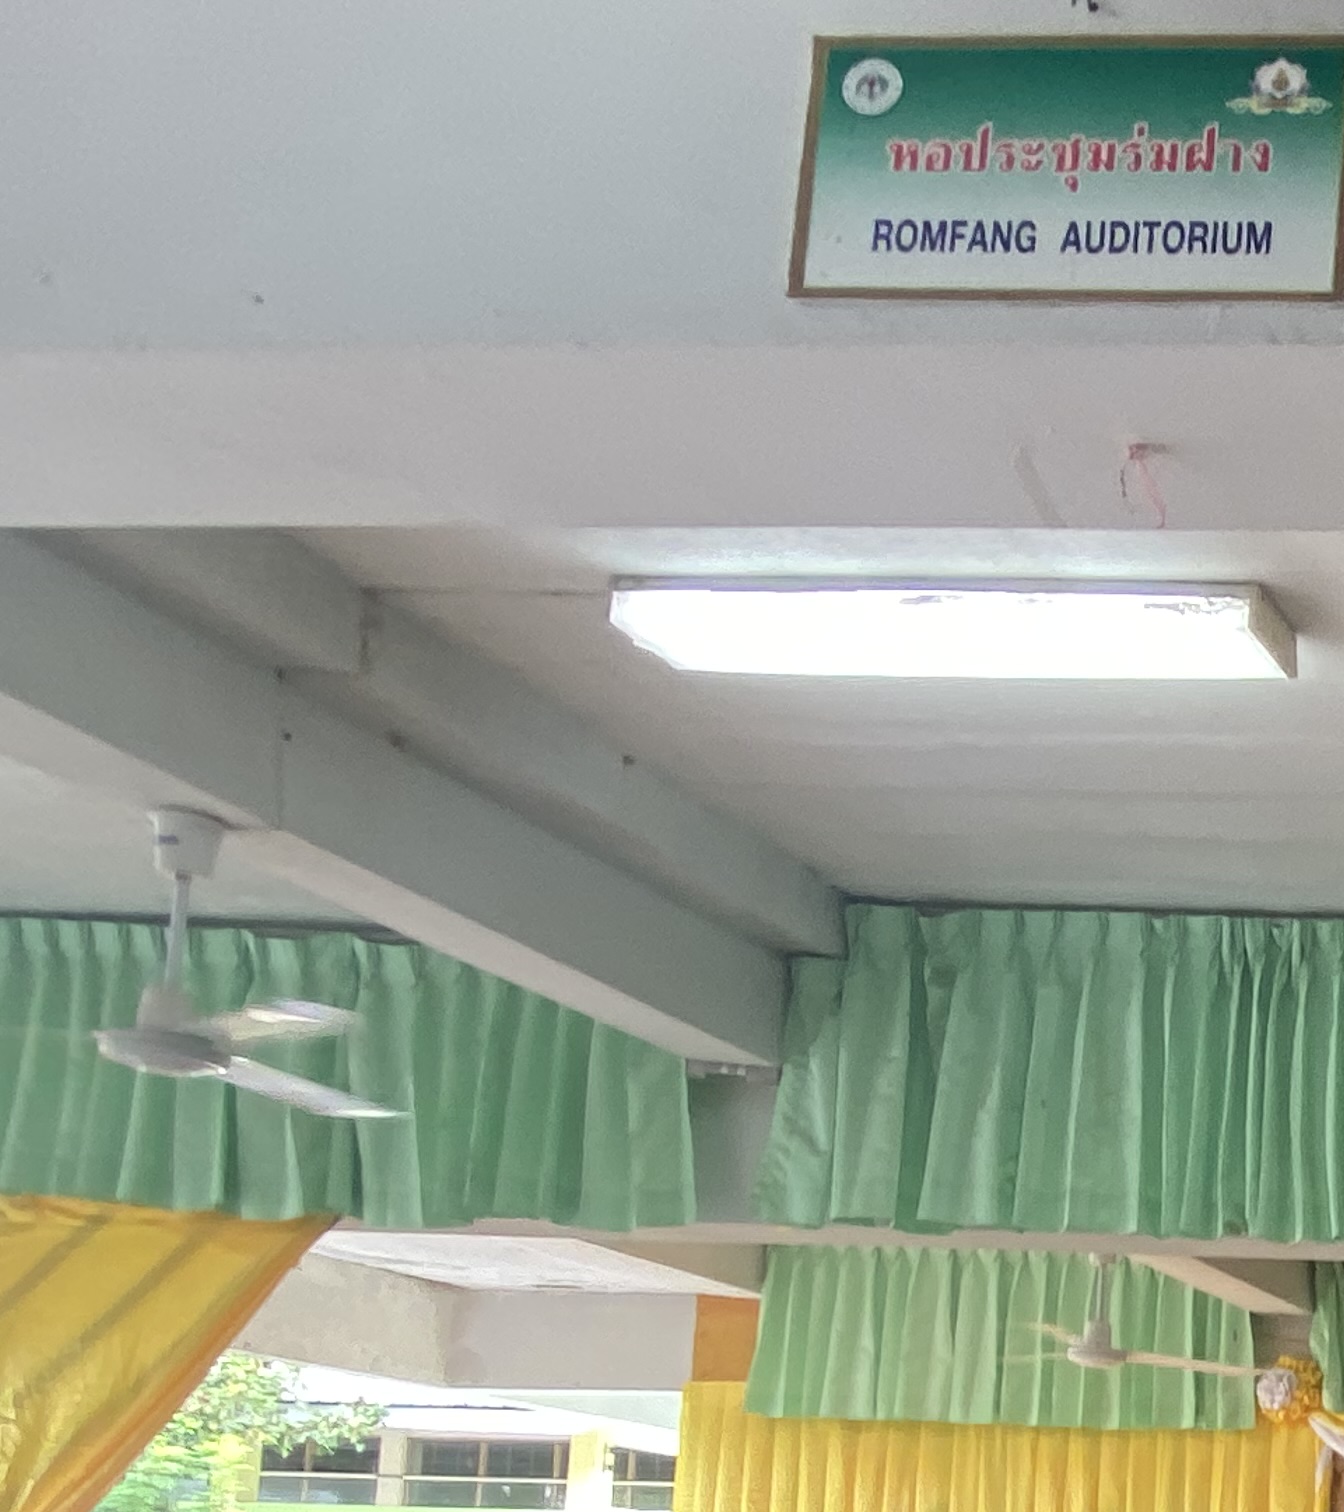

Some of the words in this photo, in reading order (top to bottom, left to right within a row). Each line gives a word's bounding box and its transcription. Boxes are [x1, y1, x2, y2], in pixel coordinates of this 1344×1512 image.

[887, 121, 1272, 193] หอประชุมร่มฝาง
[871, 218, 1037, 254] ROMFANG
[1060, 219, 1273, 255] AUDITORIUM
